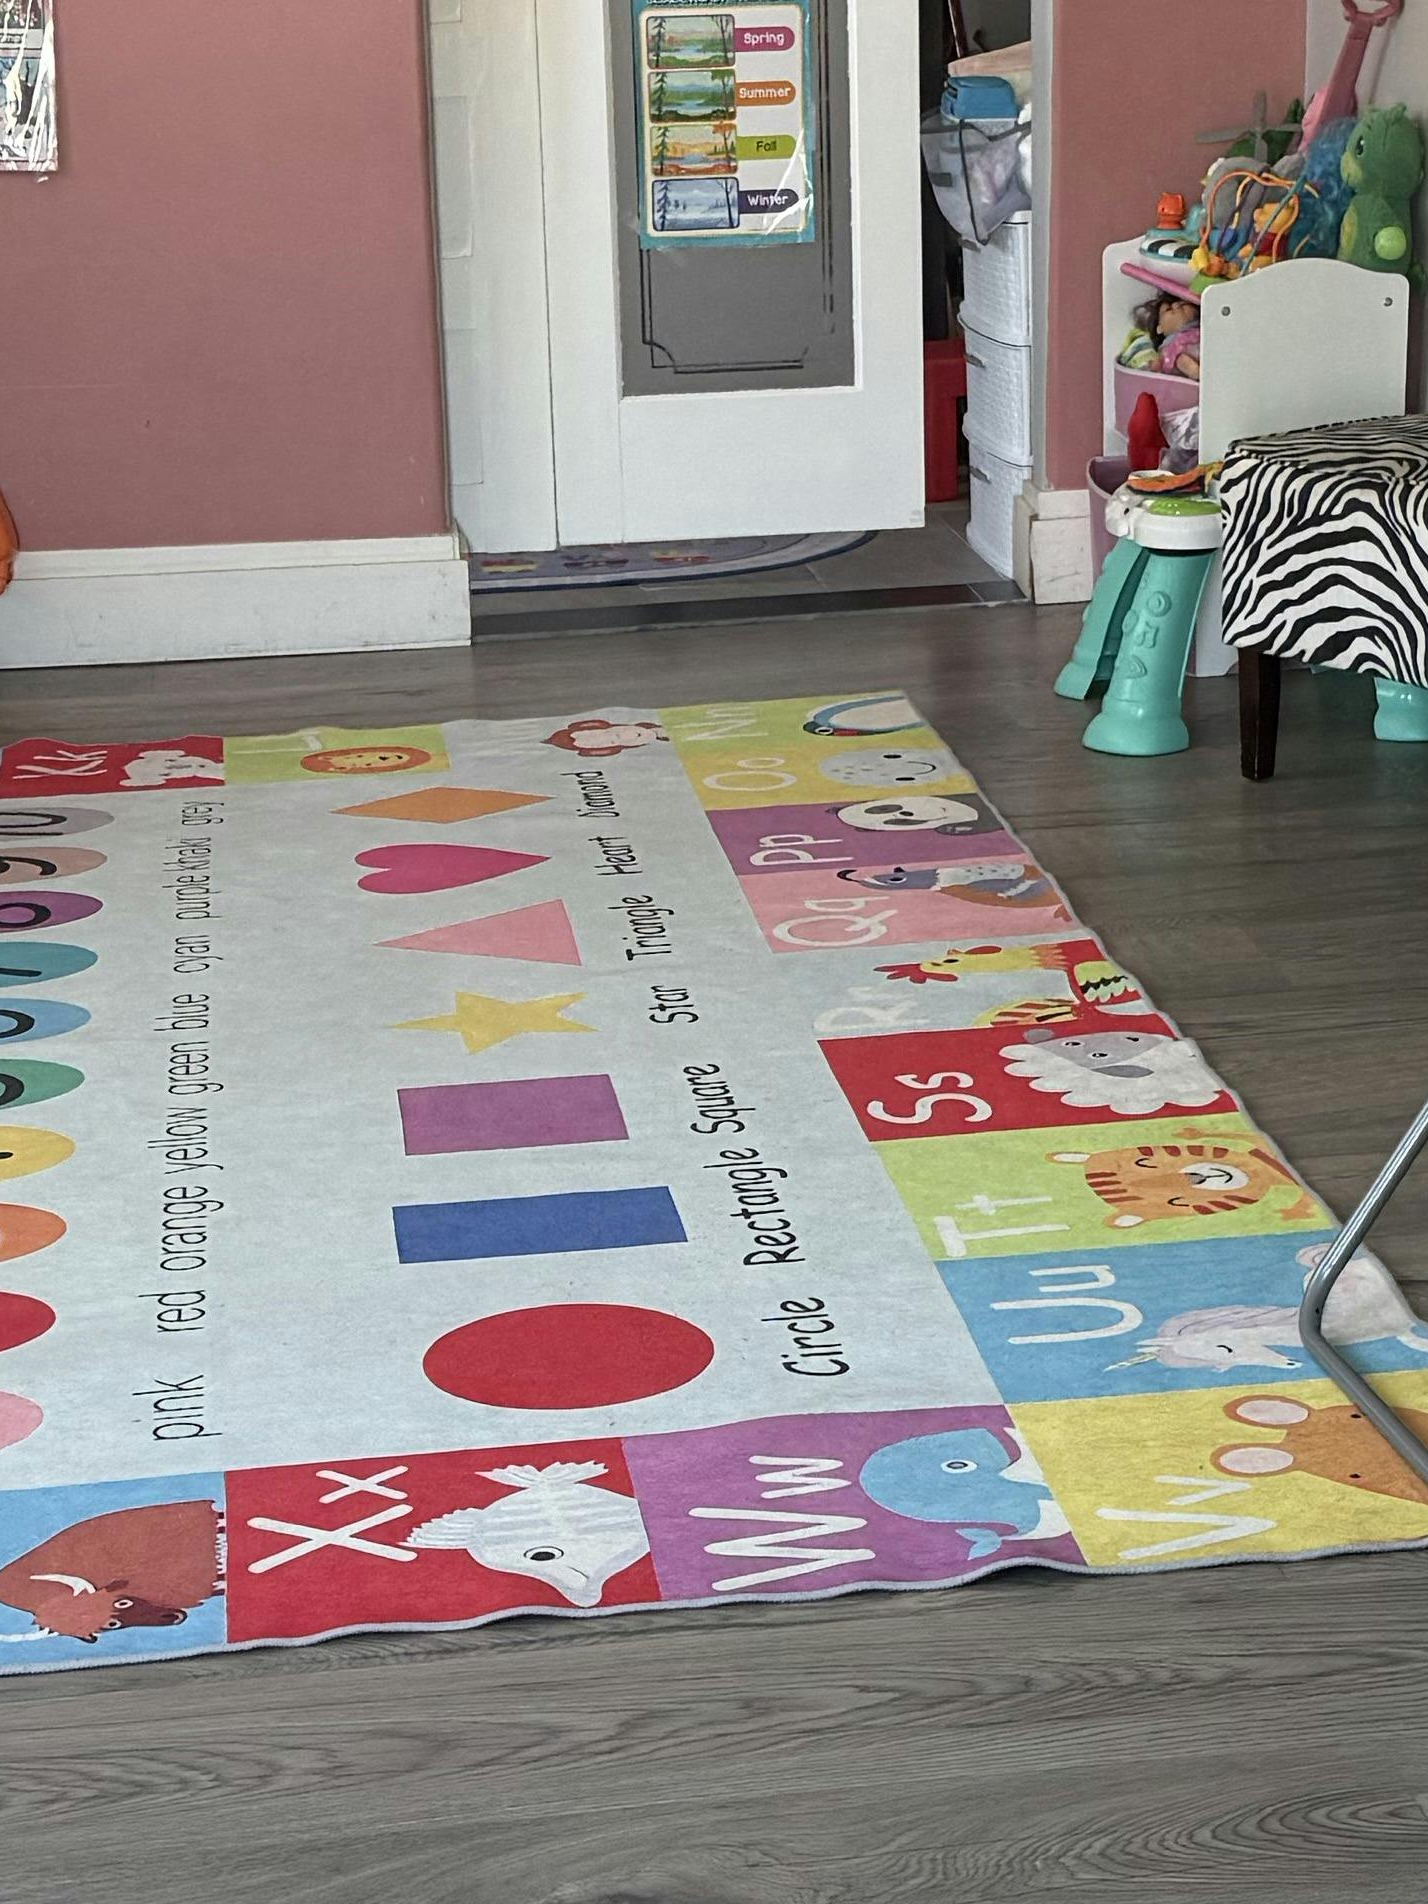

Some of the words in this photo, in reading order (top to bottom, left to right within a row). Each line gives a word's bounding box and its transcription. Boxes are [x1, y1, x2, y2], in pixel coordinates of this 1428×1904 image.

[743, 32, 786, 46] Spring
[739, 86, 792, 99] Summer
[756, 139, 778, 153] Fall
[12, 749, 108, 781] Kk
[702, 756, 798, 792] Oo
[180, 800, 225, 827] grey
[574, 769, 621, 819] Diamond
[161, 836, 212, 873] khaki
[589, 834, 644, 877] Heart
[750, 832, 843, 870] Pp
[161, 873, 223, 921] purple
[773, 894, 890, 946] Qq
[608, 894, 675, 962] Triangle
[172, 933, 224, 975] cyan
[153, 993, 210, 1032] blue
[649, 983, 700, 1027] Star
[167, 1040, 224, 1096] green
[682, 1062, 757, 1136] Square
[866, 1070, 994, 1126] Ss
[146, 1103, 225, 1178] yellow
[156, 1167, 226, 1273] orange
[703, 1145, 807, 1267] Rectangle
[934, 1192, 1071, 1259] Tt
[138, 1287, 206, 1335] red
[989, 1263, 1145, 1347] Uu
[761, 1294, 851, 1378] Circle
[130, 1372, 224, 1443] pink
[246, 1464, 418, 1575] Xx
[687, 1453, 877, 1592] Ww
[1094, 1475, 1277, 1561] Vv
